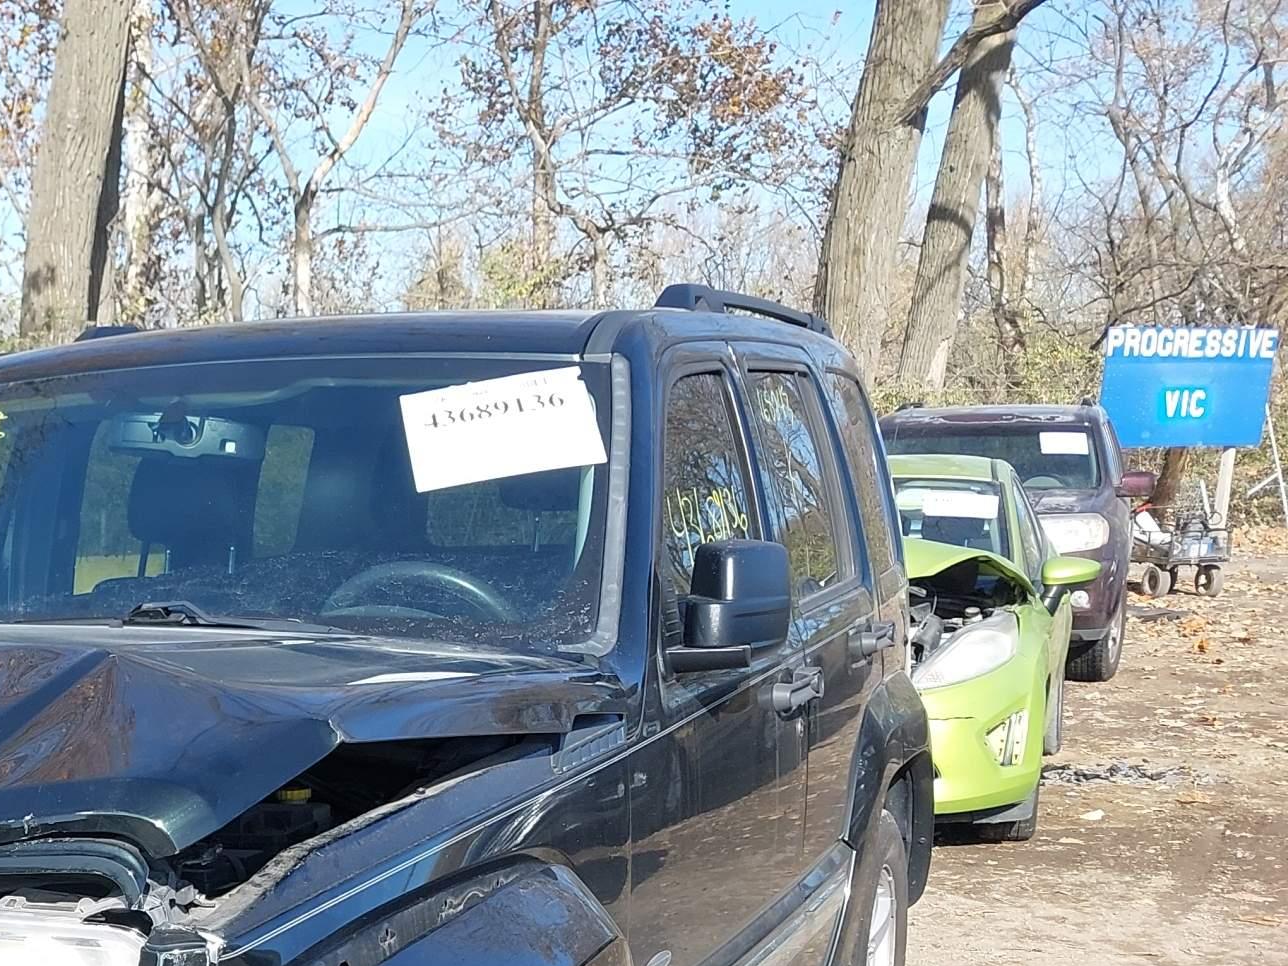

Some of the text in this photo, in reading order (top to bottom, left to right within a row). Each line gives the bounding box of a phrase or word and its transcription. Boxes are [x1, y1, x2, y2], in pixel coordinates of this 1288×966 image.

[1107, 328, 1279, 358] PROGRESSIVE
[423, 391, 565, 429] 43689136
[1165, 389, 1207, 418] VIC
